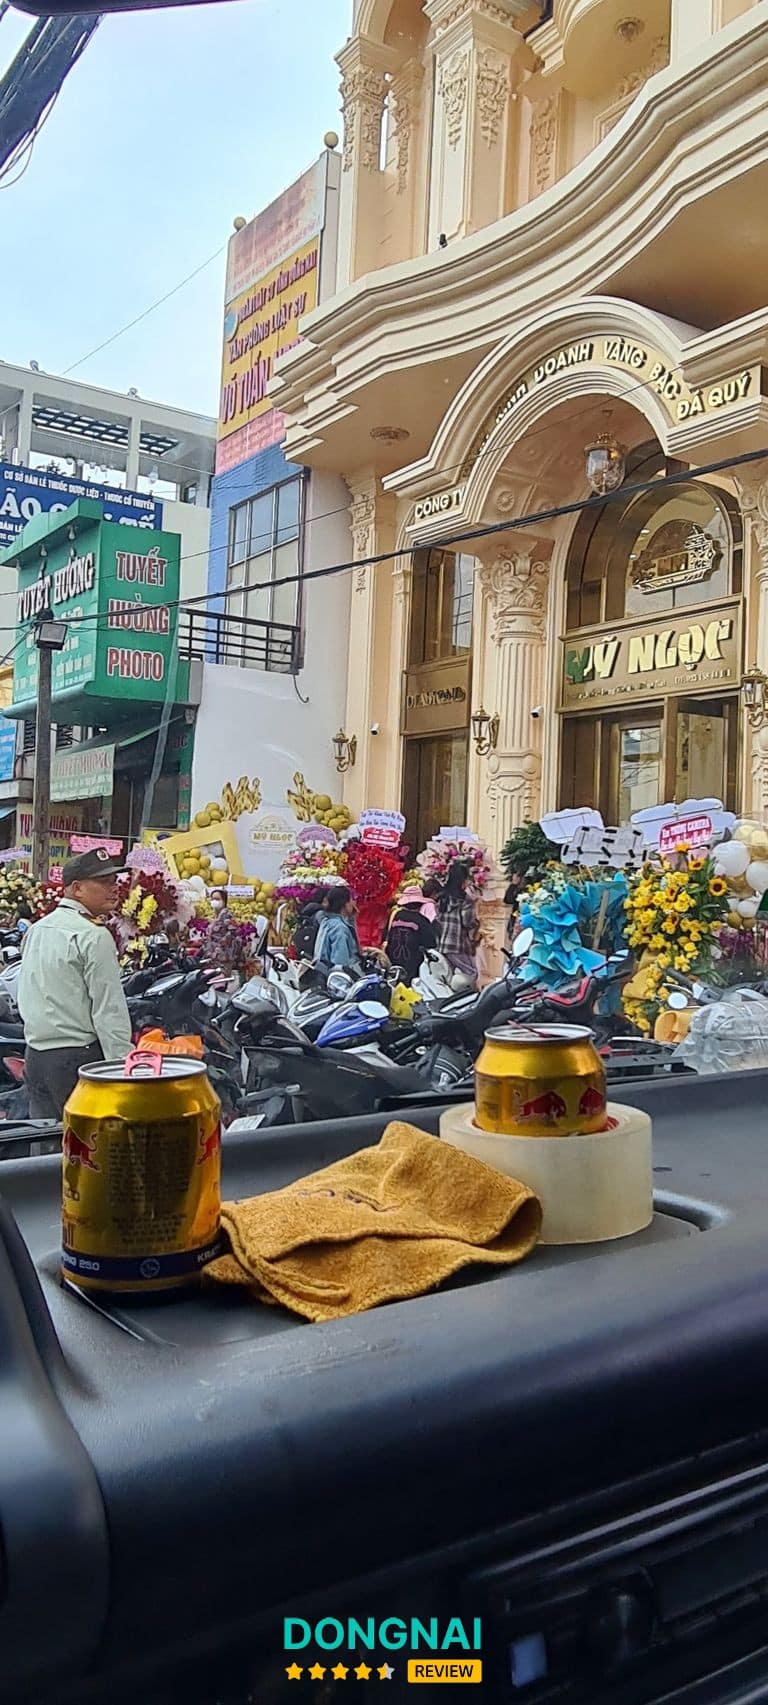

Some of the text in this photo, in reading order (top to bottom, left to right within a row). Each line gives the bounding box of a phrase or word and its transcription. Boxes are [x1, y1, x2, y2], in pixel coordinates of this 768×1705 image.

[244, 320, 270, 355] PHÒNG
[271, 302, 292, 334] LUẬT
[294, 291, 307, 318] SƯ
[221, 350, 271, 425] VŨ TUẤN
[533, 342, 593, 383] DOANH
[603, 336, 646, 368] VÀNG
[649, 361, 681, 401] BẠC
[677, 388, 703, 420] ĐÁ
[708, 370, 750, 406] QUÝ
[415, 495, 452, 519] CÔNG
[18, 552, 95, 622] TUYẾT HƯỜNG
[116, 546, 168, 587] TUYẾT
[108, 593, 170, 635] HƯỜNG
[107, 646, 164, 681] PHOTO
[628, 618, 732, 674] NGỌC
